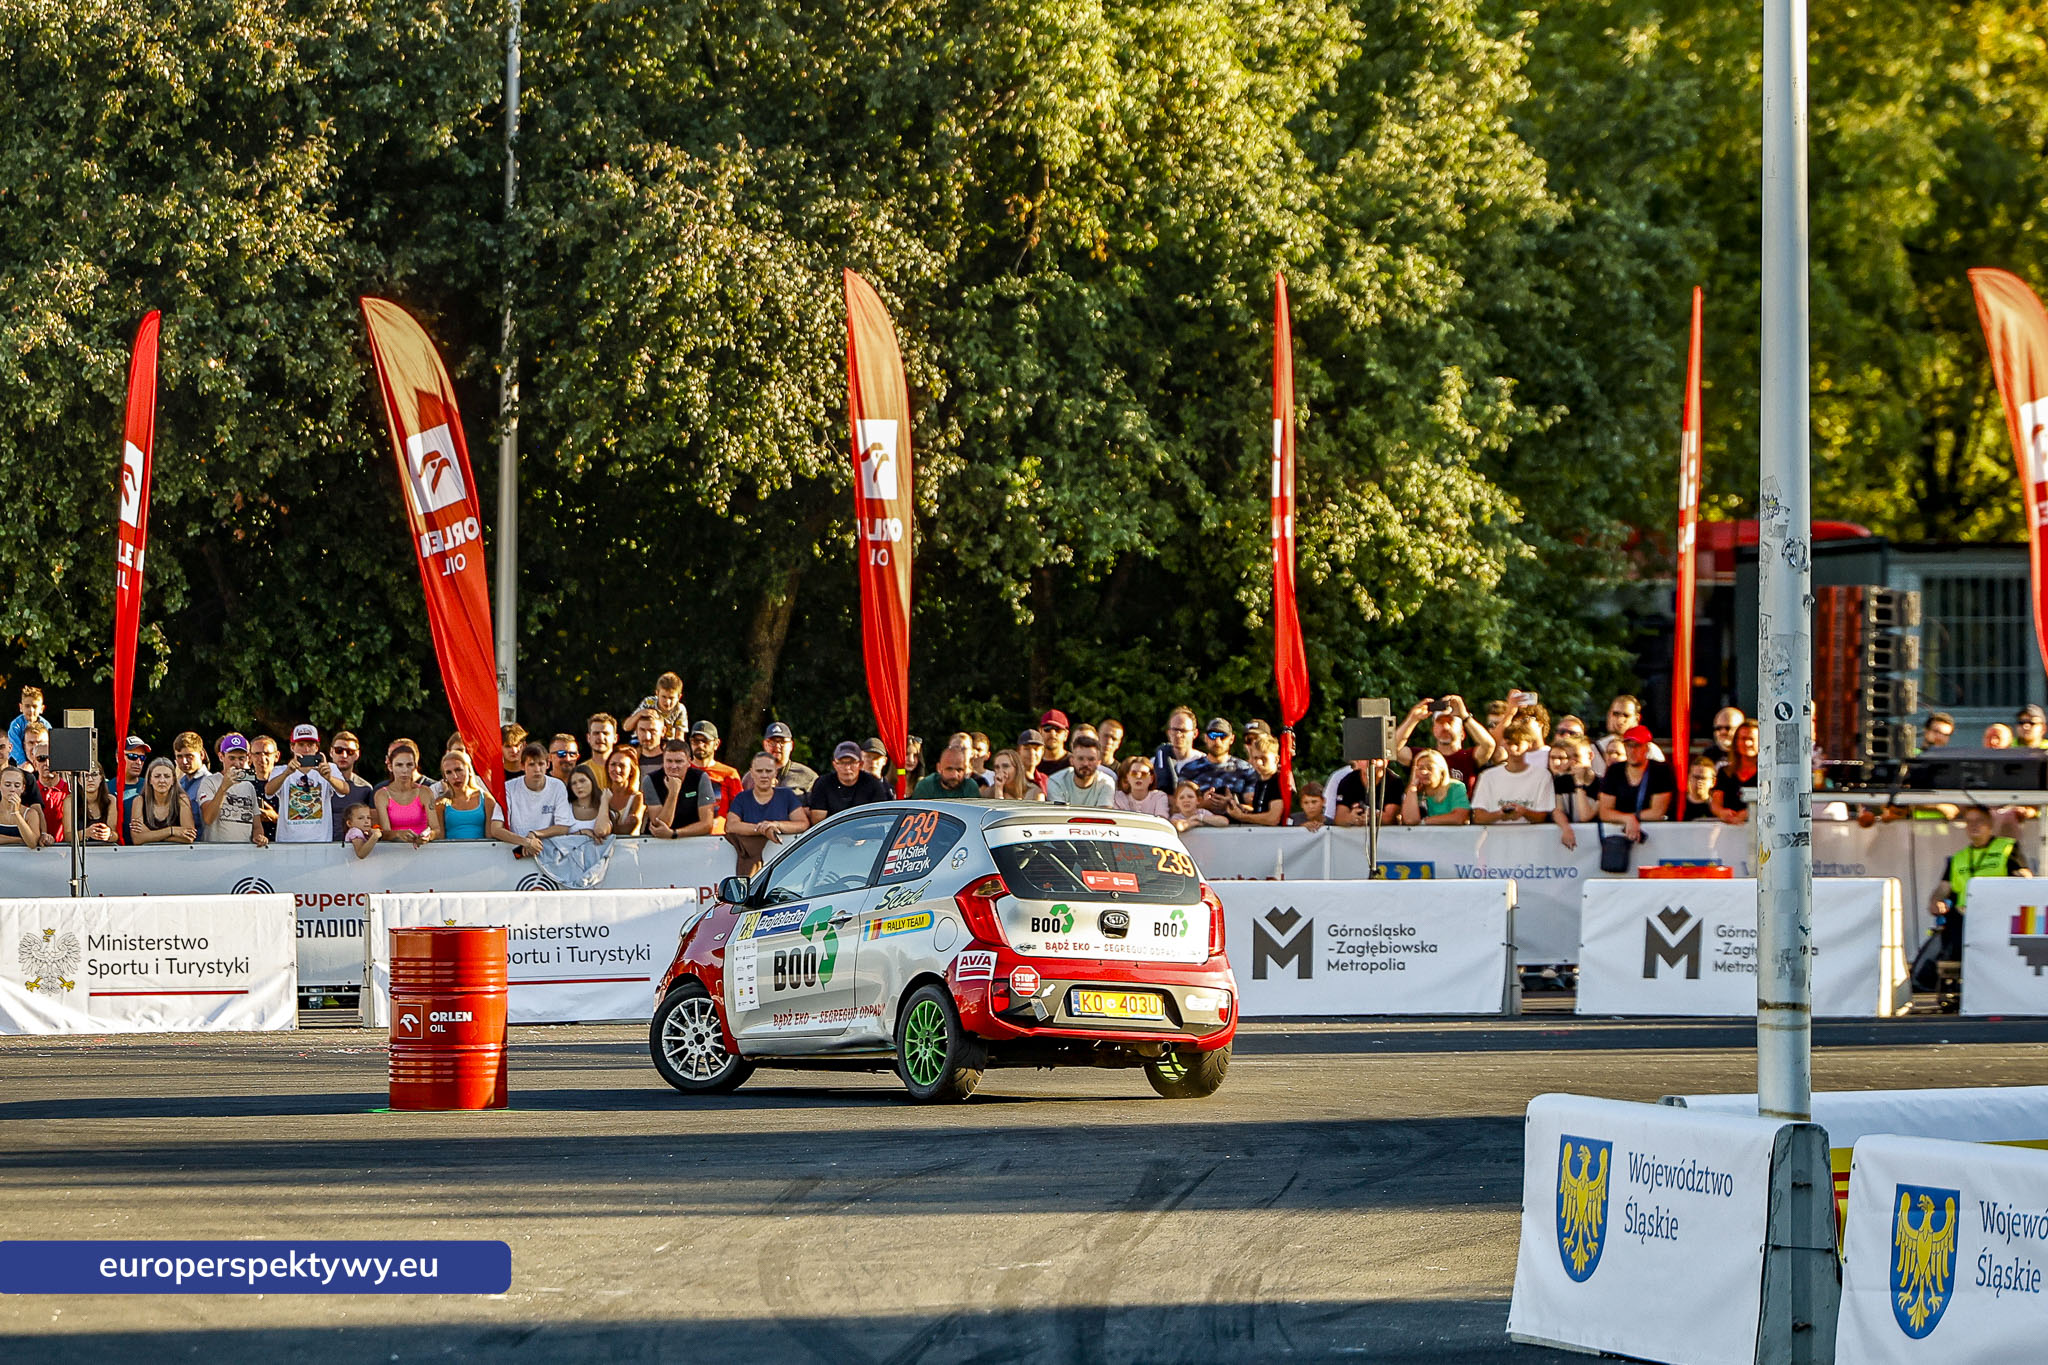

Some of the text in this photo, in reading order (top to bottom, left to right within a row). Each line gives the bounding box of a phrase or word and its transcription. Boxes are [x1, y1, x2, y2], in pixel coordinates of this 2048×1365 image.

[893, 810, 939, 850] 239
[1151, 847, 1196, 878] 239
[1454, 864, 1578, 879] Województwo
[507, 923, 610, 941] inisterstwo
[887, 916, 925, 931] RALLY TEAM
[1031, 917, 1061, 933] BOO
[1327, 923, 1416, 940] Górnośląsko
[88, 934, 209, 951] Ministerstwo
[1072, 942, 1091, 951] EKO
[556, 946, 561, 964] i
[566, 943, 651, 966] Turystyki
[87, 956, 250, 979] Sportu i Turystyki
[773, 945, 817, 992] BOO
[1327, 957, 1406, 975] Metropolia
[1014, 973, 1036, 983] STOP
[429, 1011, 473, 1022] ORLEN
[429, 1024, 446, 1033] OIL
[1628, 1151, 1733, 1198] Województwo
[1624, 1195, 1679, 1245] Śląskie
[1975, 1246, 2041, 1299] Śląskie
